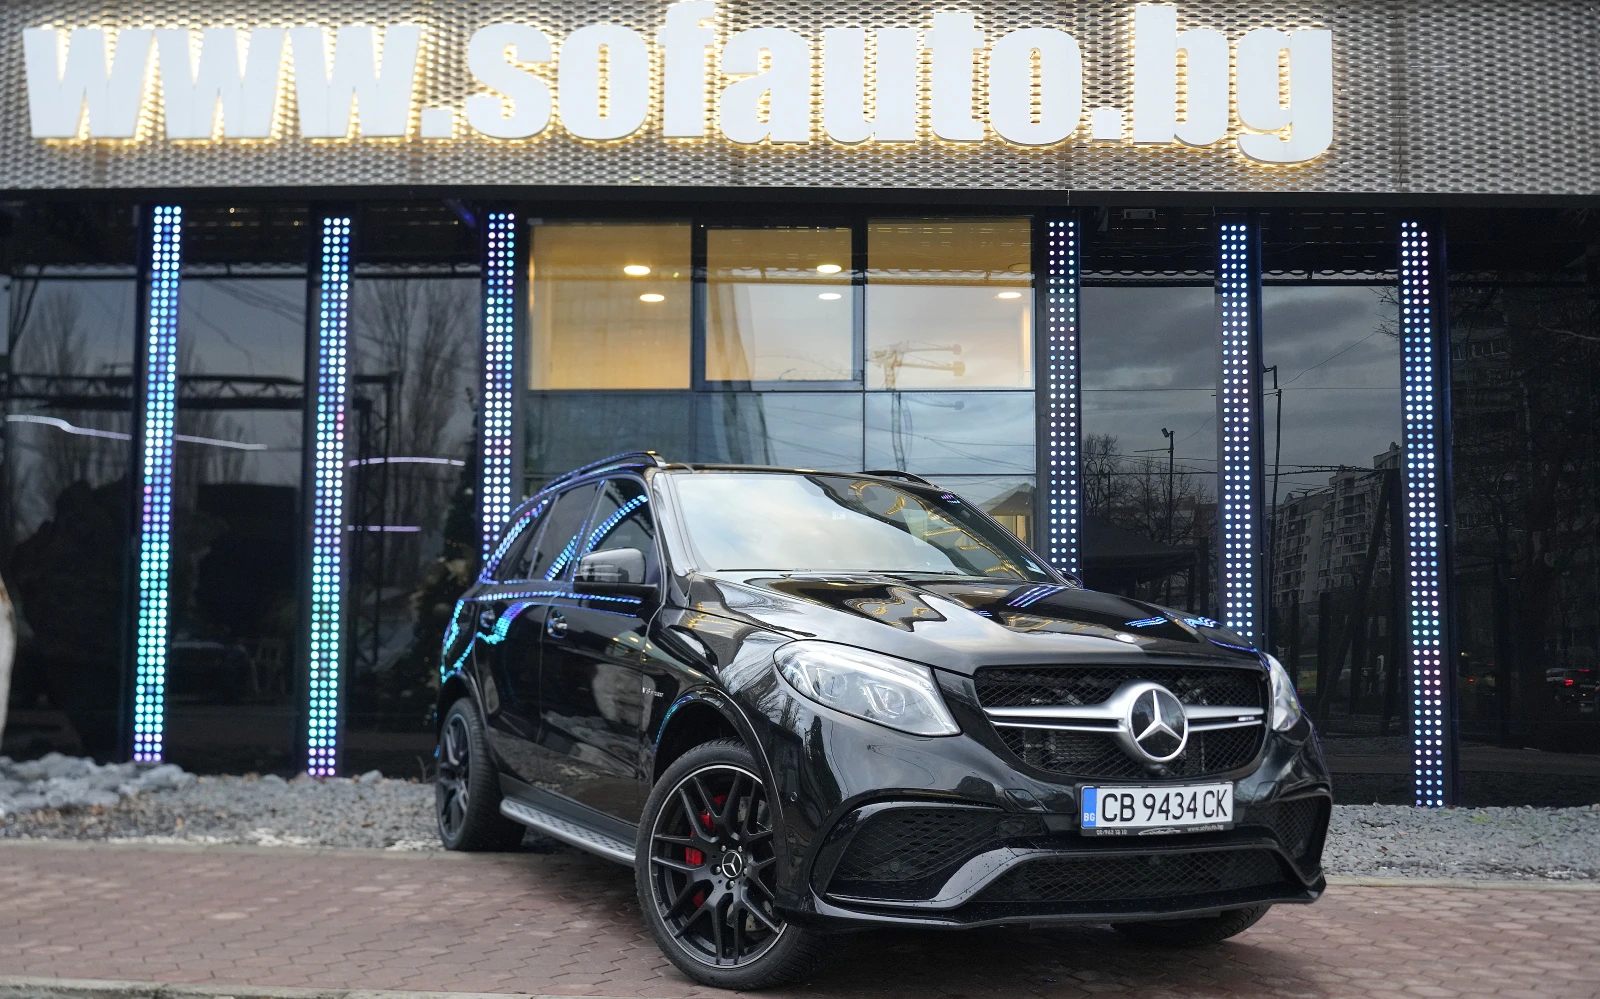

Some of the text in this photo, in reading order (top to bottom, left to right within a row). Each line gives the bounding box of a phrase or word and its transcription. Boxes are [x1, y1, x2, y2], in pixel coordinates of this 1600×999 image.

[22, 1, 1333, 163] www.sofauto.bg
[1083, 812, 1095, 822] BG
[1101, 789, 1228, 822] CB 9434 CK
